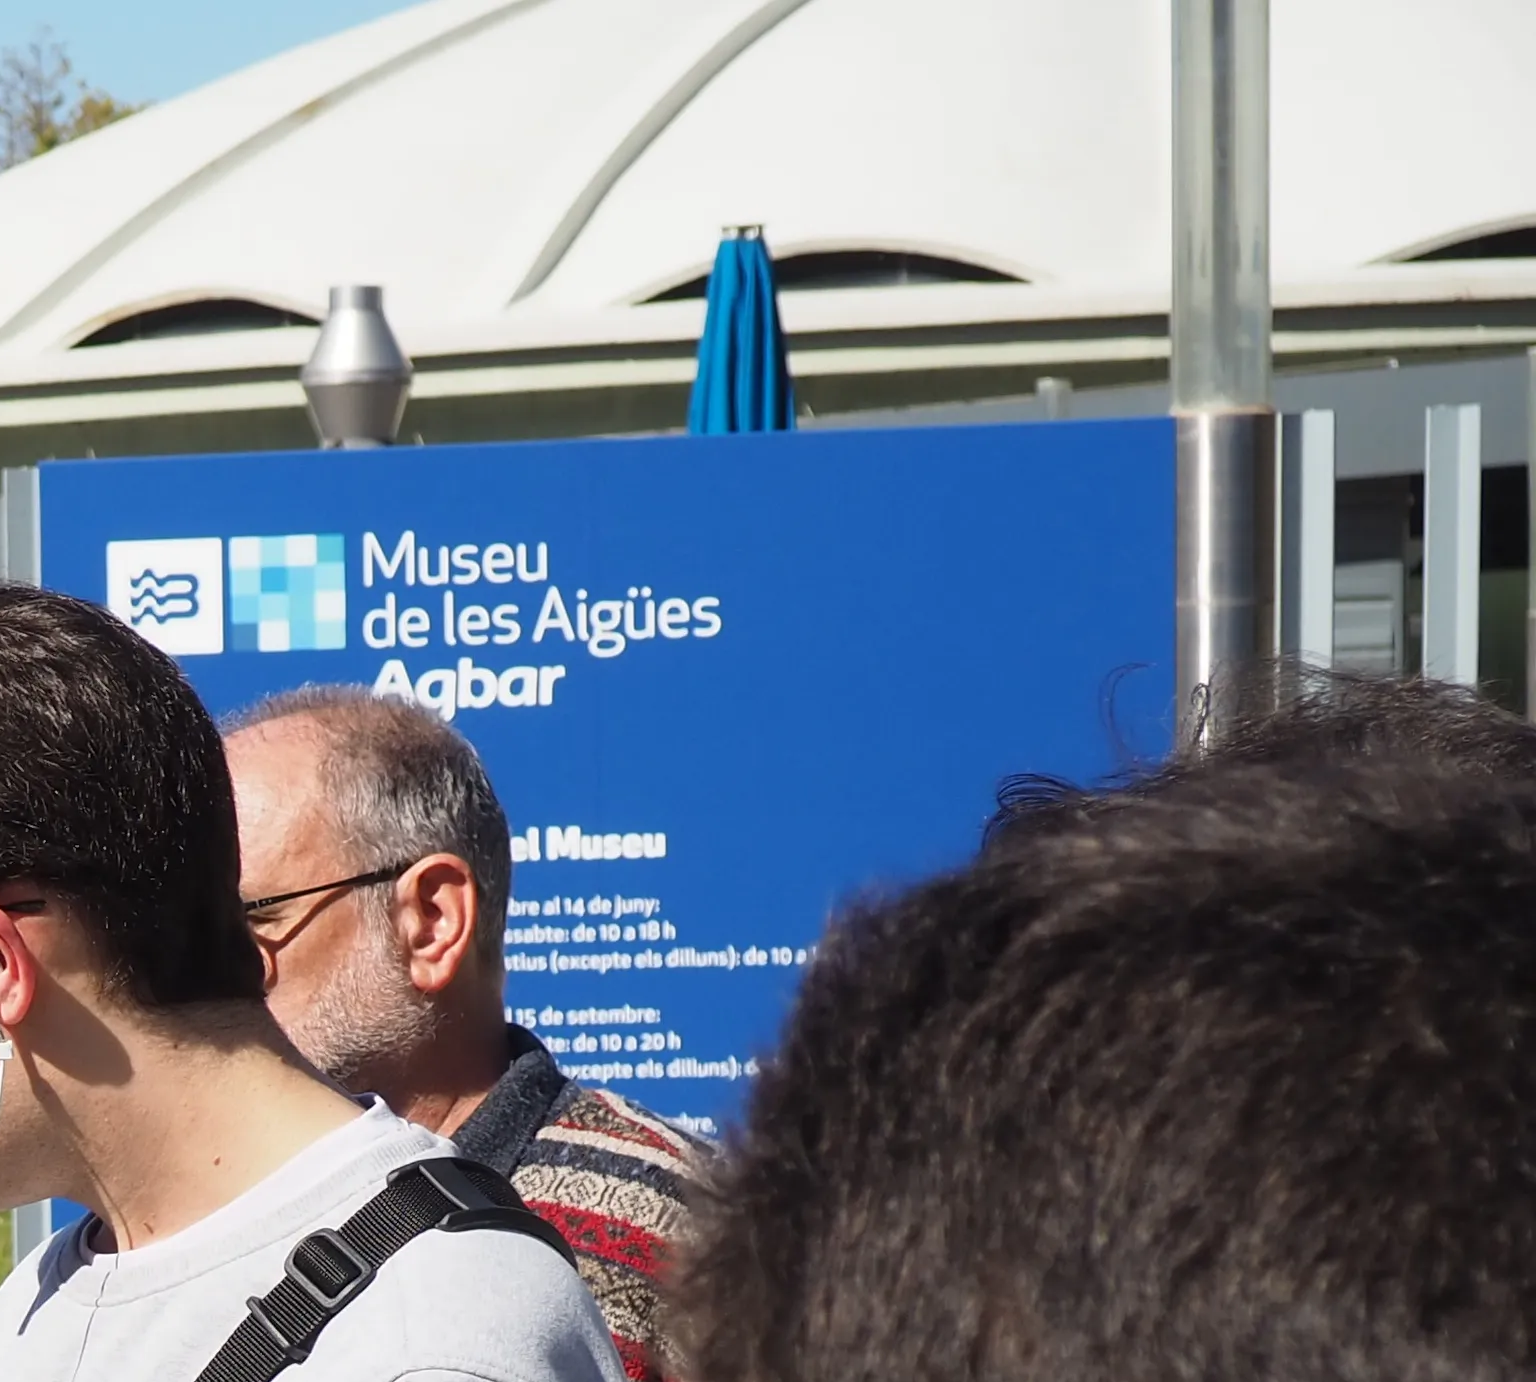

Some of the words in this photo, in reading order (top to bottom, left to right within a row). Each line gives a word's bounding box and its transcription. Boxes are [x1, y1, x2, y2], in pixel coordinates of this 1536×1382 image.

[362, 530, 548, 587] Museu
[362, 591, 430, 649] de
[443, 590, 521, 646] les
[532, 585, 723, 658] Aigües
[374, 656, 566, 722] Agbar
[546, 825, 667, 861] Museu
[506, 896, 540, 916] bre
[543, 896, 561, 916] al
[564, 897, 585, 917] 14
[588, 895, 612, 916] de
[504, 923, 570, 944] ssabte:
[572, 923, 596, 942] de
[599, 923, 621, 942] 10
[623, 926, 636, 940] a
[639, 920, 660, 940] 18
[662, 919, 676, 940] h
[550, 949, 632, 974] (excepte
[634, 949, 662, 969] els
[665, 945, 741, 970] dilluns):
[743, 945, 767, 965] de
[771, 946, 792, 965] 10
[795, 949, 807, 964] a
[516, 1007, 537, 1029] 15
[539, 1005, 564, 1027] de
[566, 1003, 661, 1026] setembre:
[572, 1032, 598, 1053] de
[601, 1033, 622, 1052] 10
[624, 1036, 638, 1051] a
[640, 1032, 665, 1052] 20
[667, 1030, 681, 1050] h
[635, 1058, 664, 1078] els
[666, 1055, 742, 1081] dilluns):
